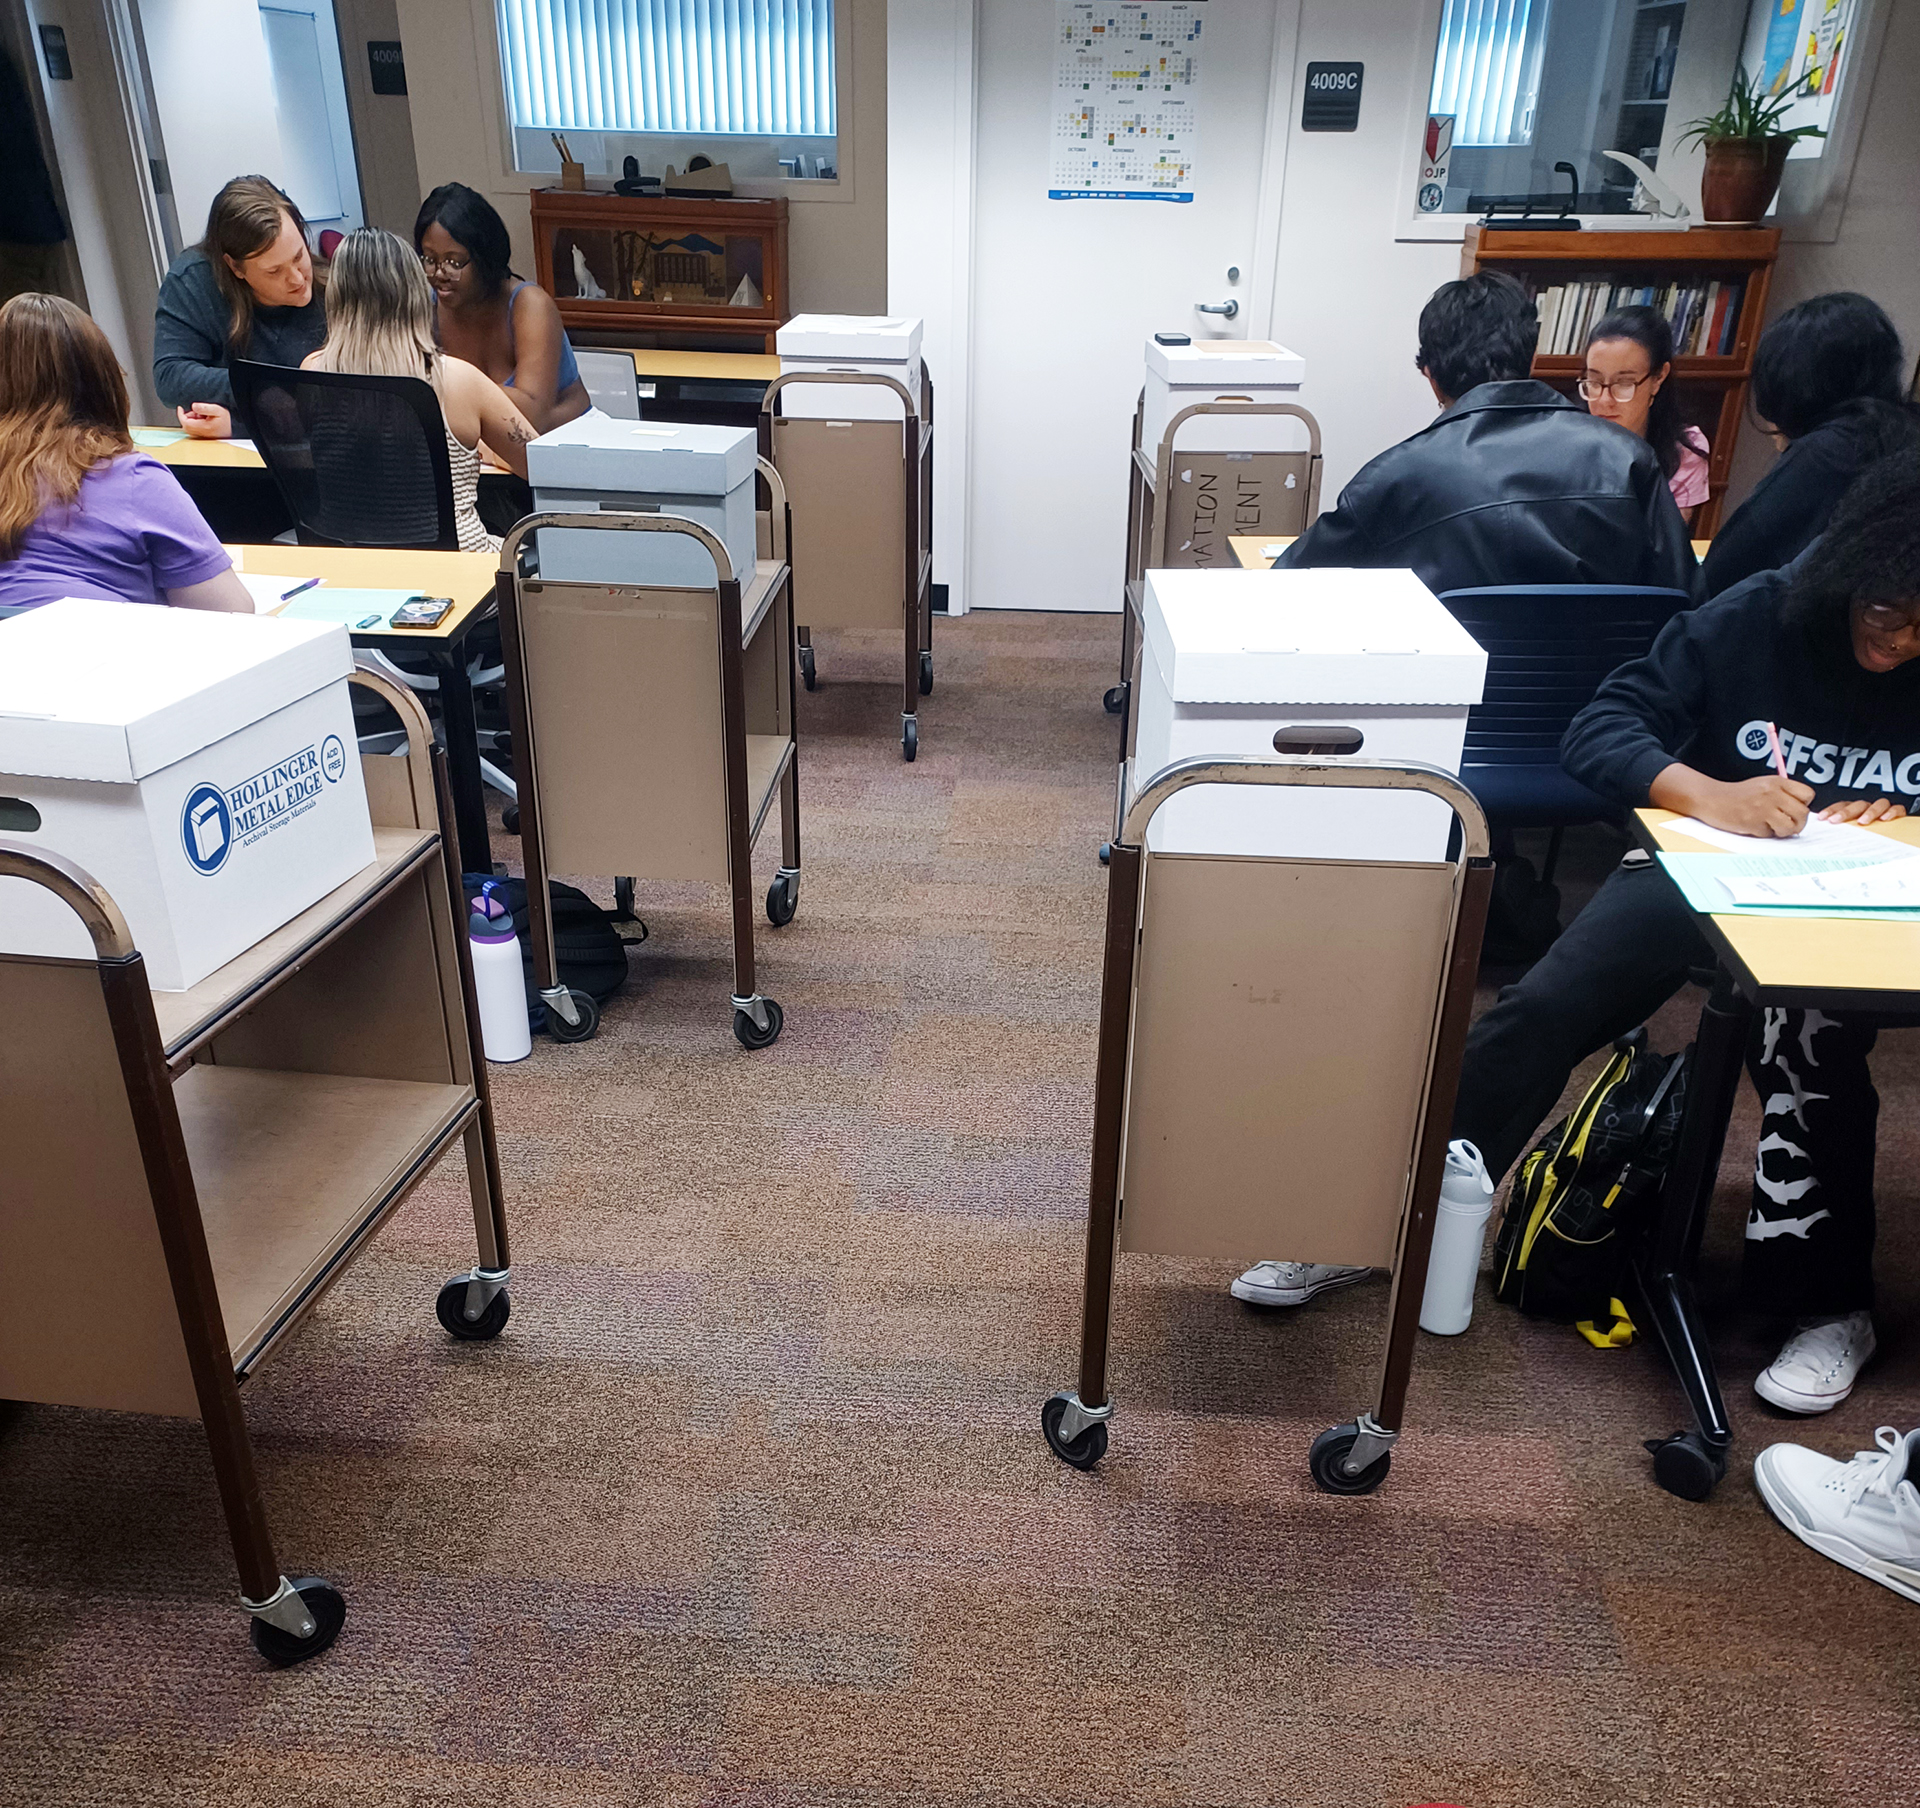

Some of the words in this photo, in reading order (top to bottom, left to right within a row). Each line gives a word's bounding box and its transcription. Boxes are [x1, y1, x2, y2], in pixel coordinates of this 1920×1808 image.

[372, 50, 403, 63] 4009
[1310, 72, 1358, 90] 4009C
[327, 747, 338, 759] ACID
[328, 760, 341, 771] FREE
[230, 750, 318, 812] HOLLINGER
[234, 794, 284, 836] METAL
[287, 771, 322, 806] EDGE
[243, 827, 268, 848] Archival
[269, 814, 290, 831] Storage
[291, 800, 316, 818] Materials
